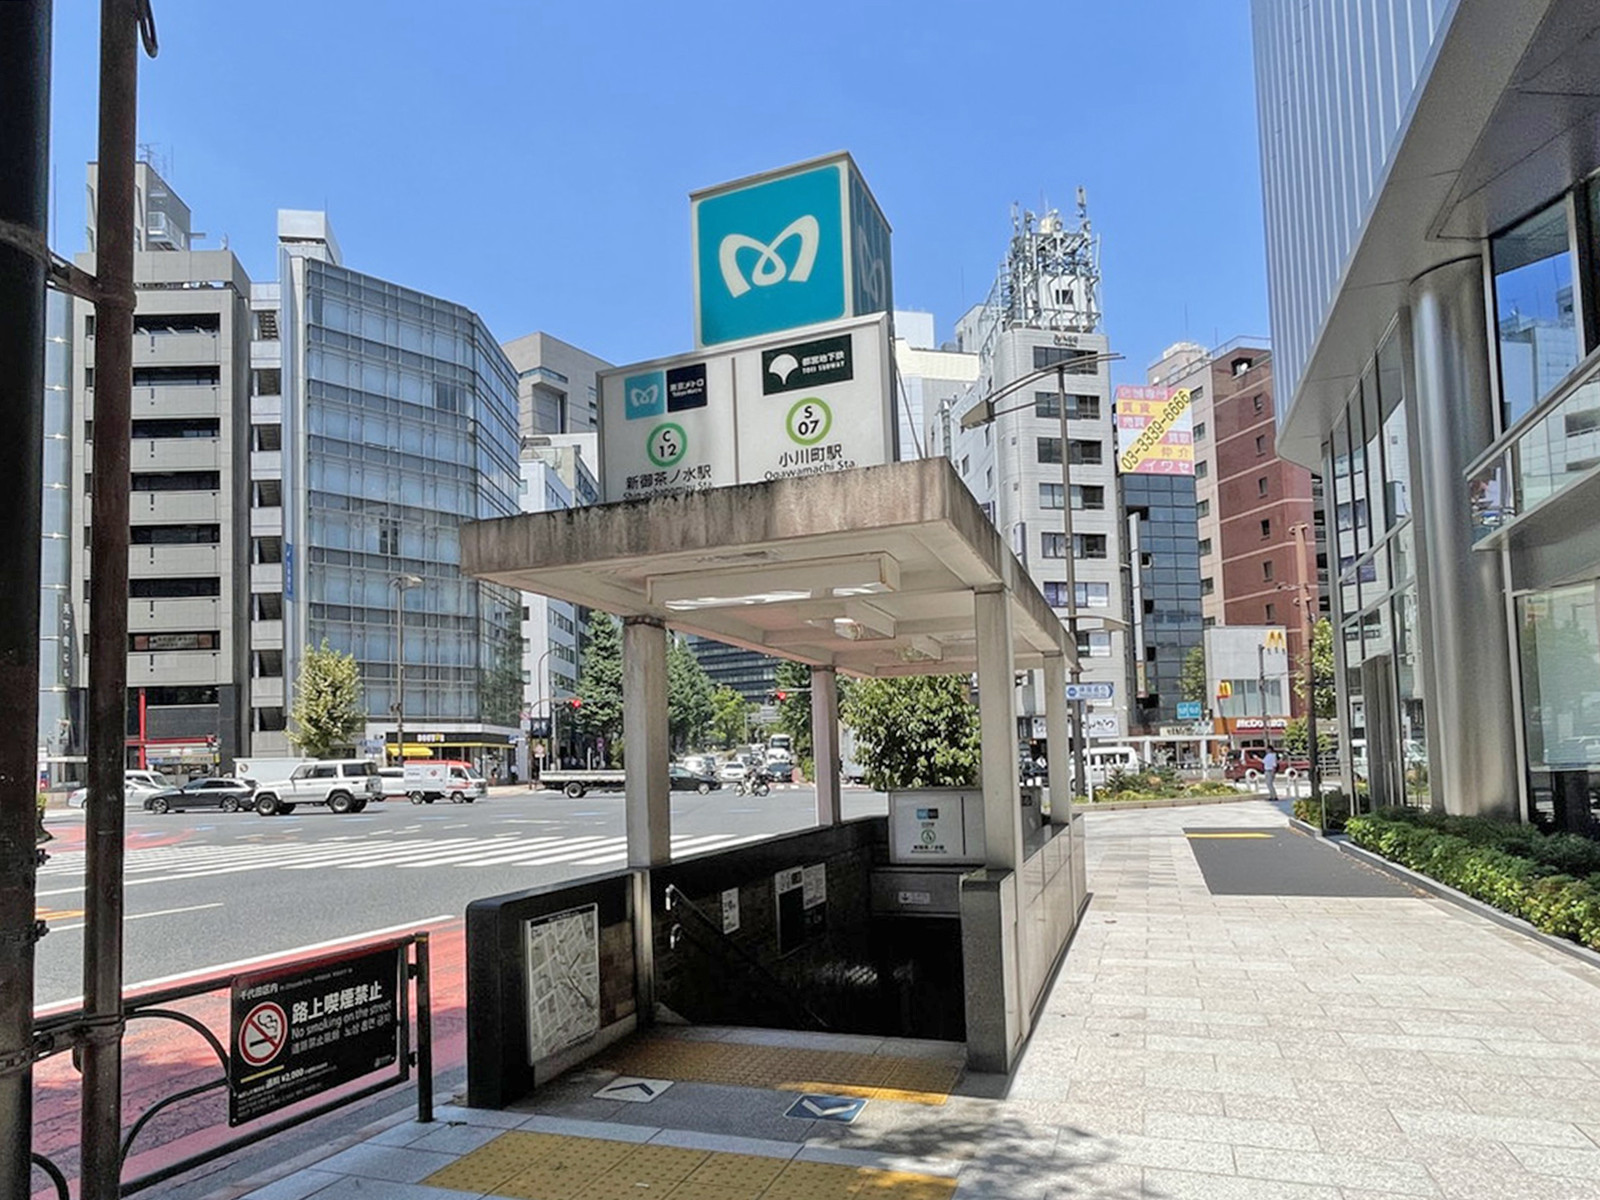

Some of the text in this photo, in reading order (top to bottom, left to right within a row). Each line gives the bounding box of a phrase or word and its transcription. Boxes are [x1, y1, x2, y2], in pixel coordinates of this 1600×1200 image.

[804, 405, 813, 419] S
[662, 430, 671, 442] C
[798, 419, 820, 435] 07
[1121, 390, 1190, 470] 03-3339-6666
[659, 443, 677, 458] 12
[778, 443, 842, 468] 小川町駅
[626, 464, 712, 490] 新御茶ノ水駅
[1144, 460, 1190, 474] イワセ
[292, 981, 383, 1025] 路上喫煙禁止
[292, 1026, 305, 1040] No
[306, 1016, 342, 1036] smoking
[343, 1012, 355, 1023] on
[355, 1007, 369, 1020] the
